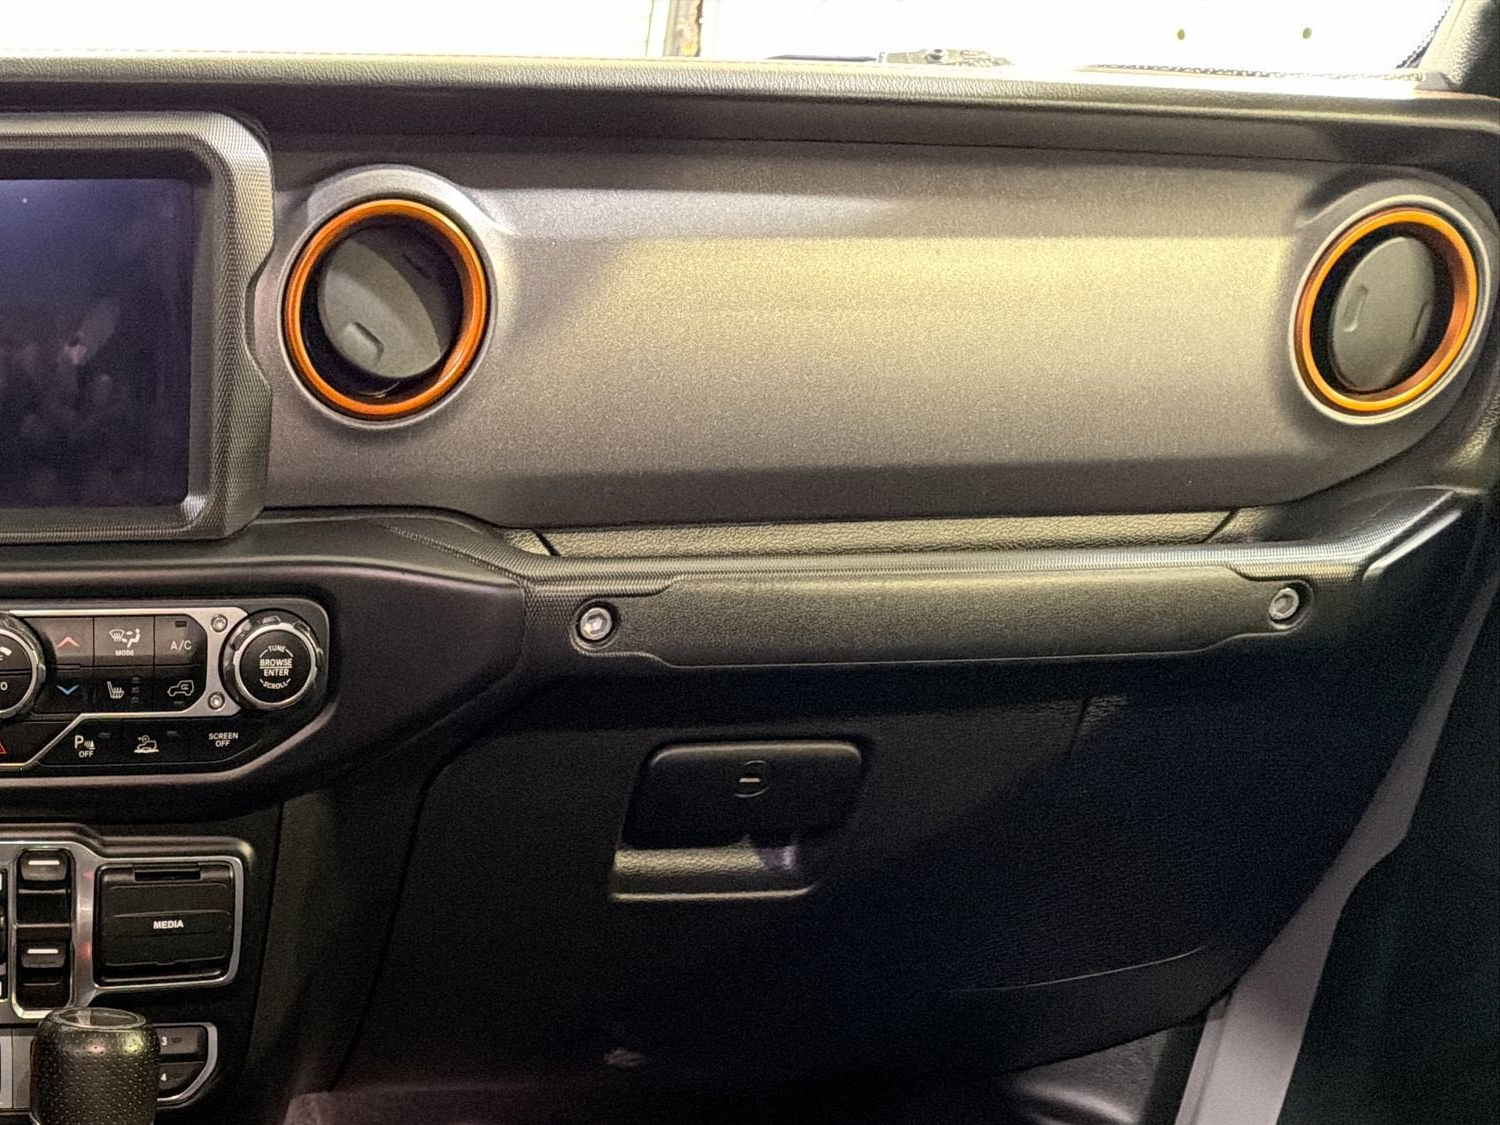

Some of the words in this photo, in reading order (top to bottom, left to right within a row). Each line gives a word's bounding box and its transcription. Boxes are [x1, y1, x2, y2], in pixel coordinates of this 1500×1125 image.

[170, 640, 192, 651] A/C
[267, 644, 286, 653] TUNE
[259, 658, 293, 667] BROWSE
[263, 669, 290, 677] ENTER
[262, 680, 289, 690] SCROLL
[208, 732, 239, 741] SCREEN
[215, 740, 231, 748] OFF
[153, 919, 184, 930] MEDIA
[160, 1036, 168, 1047] 3
[160, 1073, 167, 1082] 4
